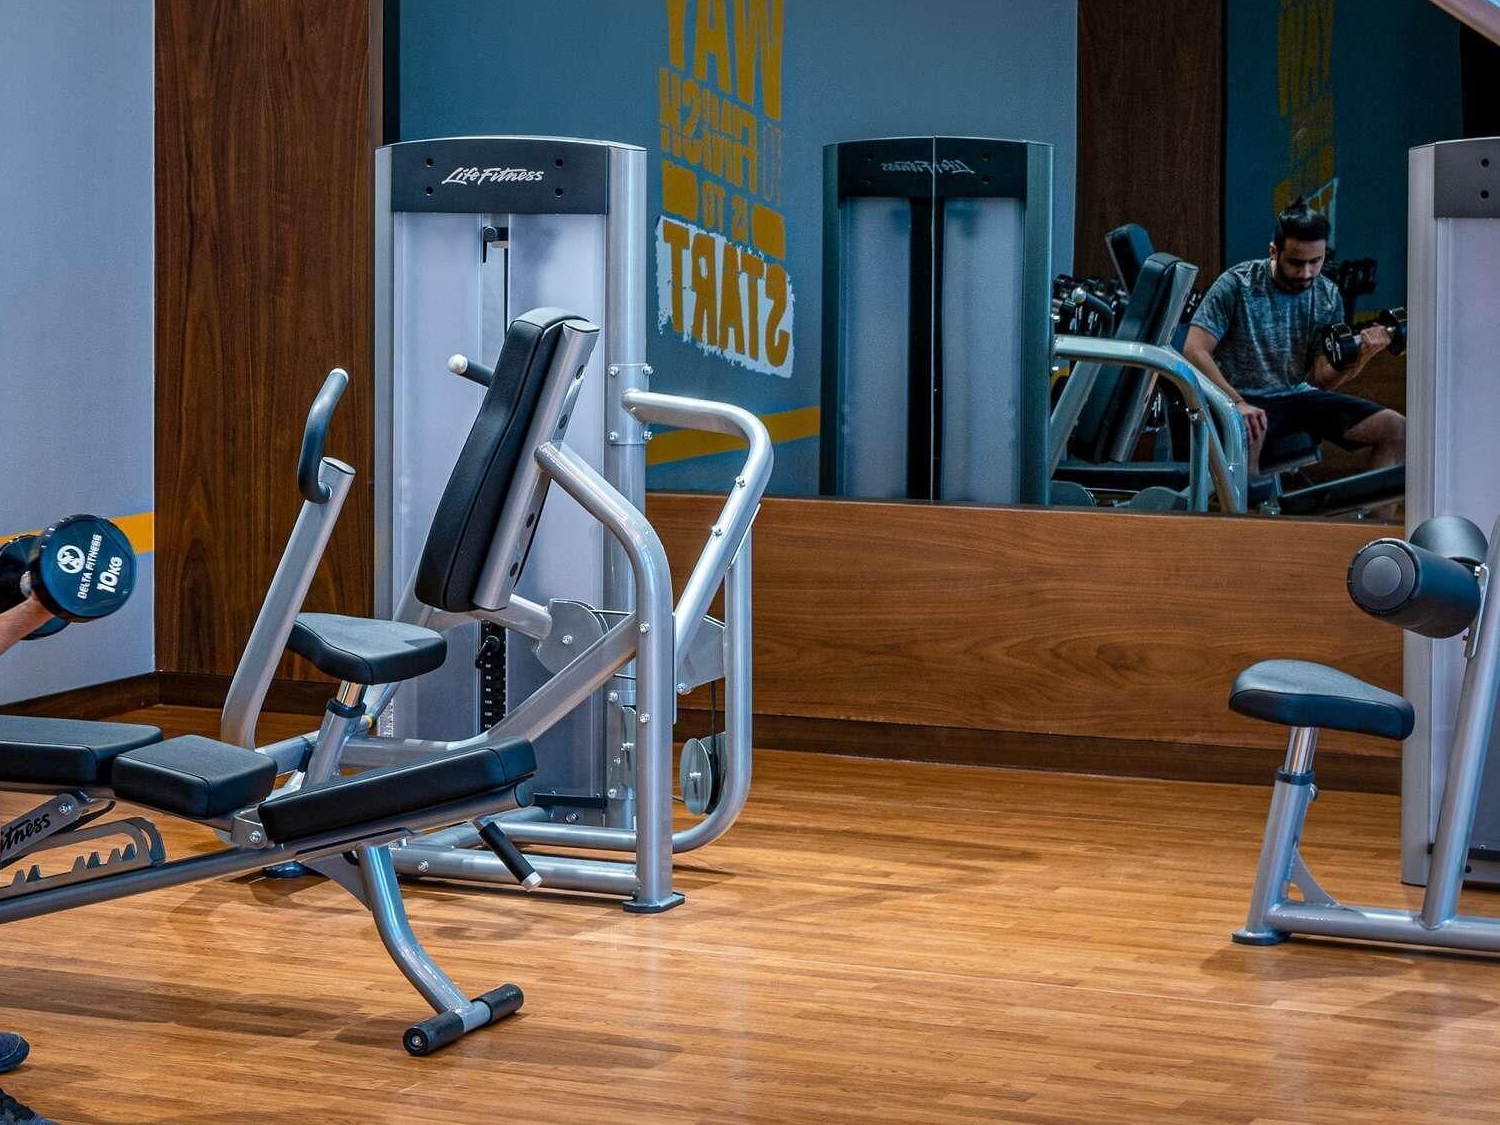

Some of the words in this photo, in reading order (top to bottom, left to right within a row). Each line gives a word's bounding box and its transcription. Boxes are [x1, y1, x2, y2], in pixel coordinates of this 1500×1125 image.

[77, 572, 93, 599] DELTA
[85, 533, 102, 571] FITNESS
[96, 556, 123, 593] 10KG
